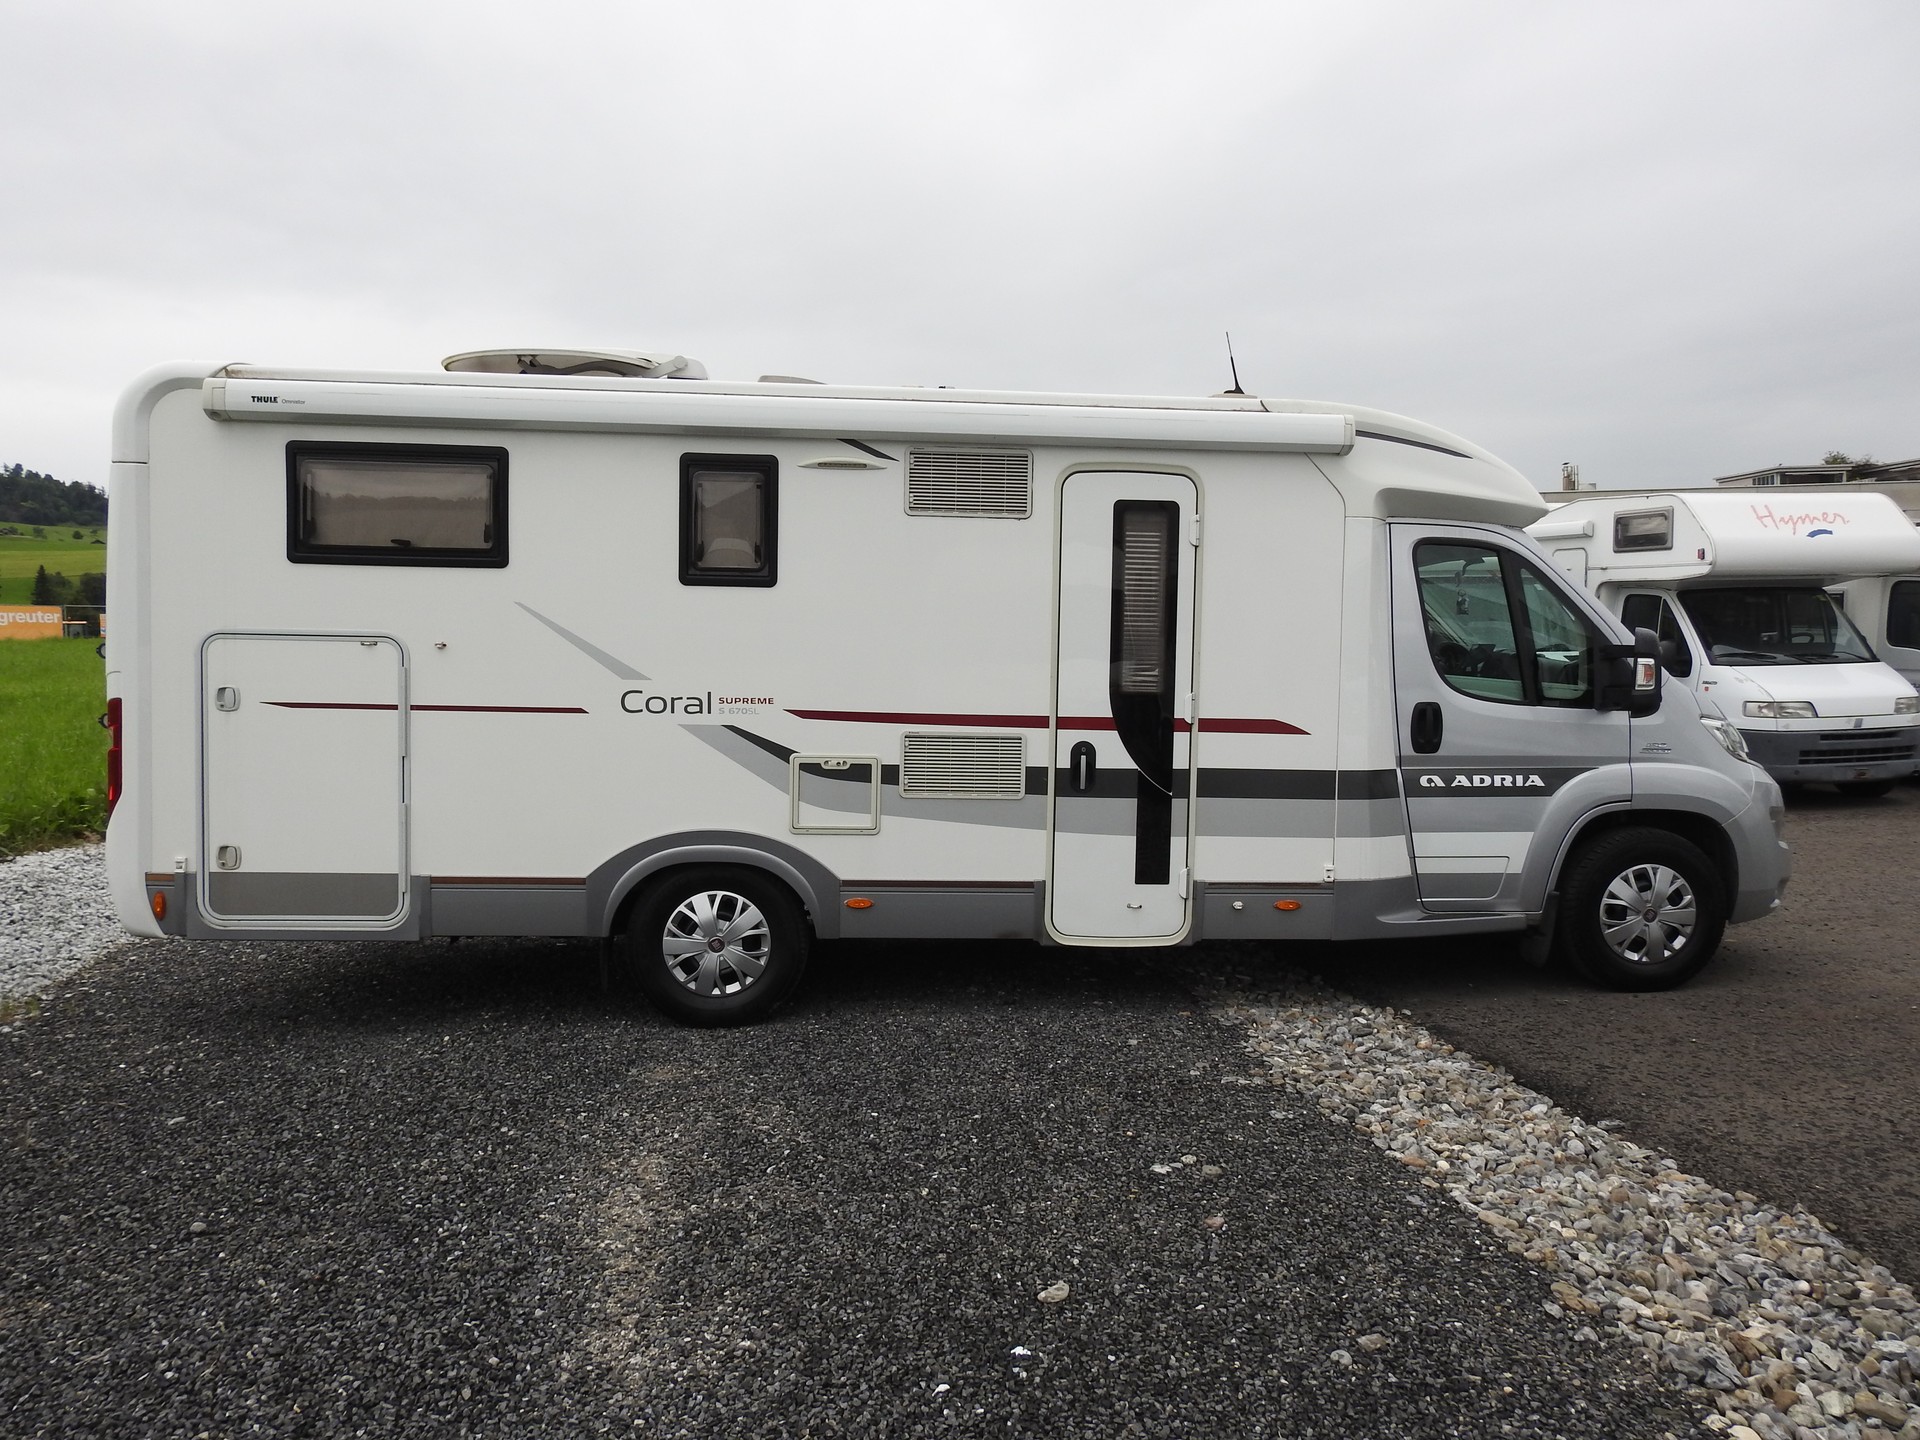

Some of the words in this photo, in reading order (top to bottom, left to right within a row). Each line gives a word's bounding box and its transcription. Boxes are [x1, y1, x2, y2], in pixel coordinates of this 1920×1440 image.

[251, 395, 278, 404] THULE
[620, 690, 712, 715] Coral
[718, 697, 775, 705] SUPREME
[718, 707, 725, 715] S
[728, 707, 760, 715] 670SL
[1450, 774, 1546, 787] ADRIA
